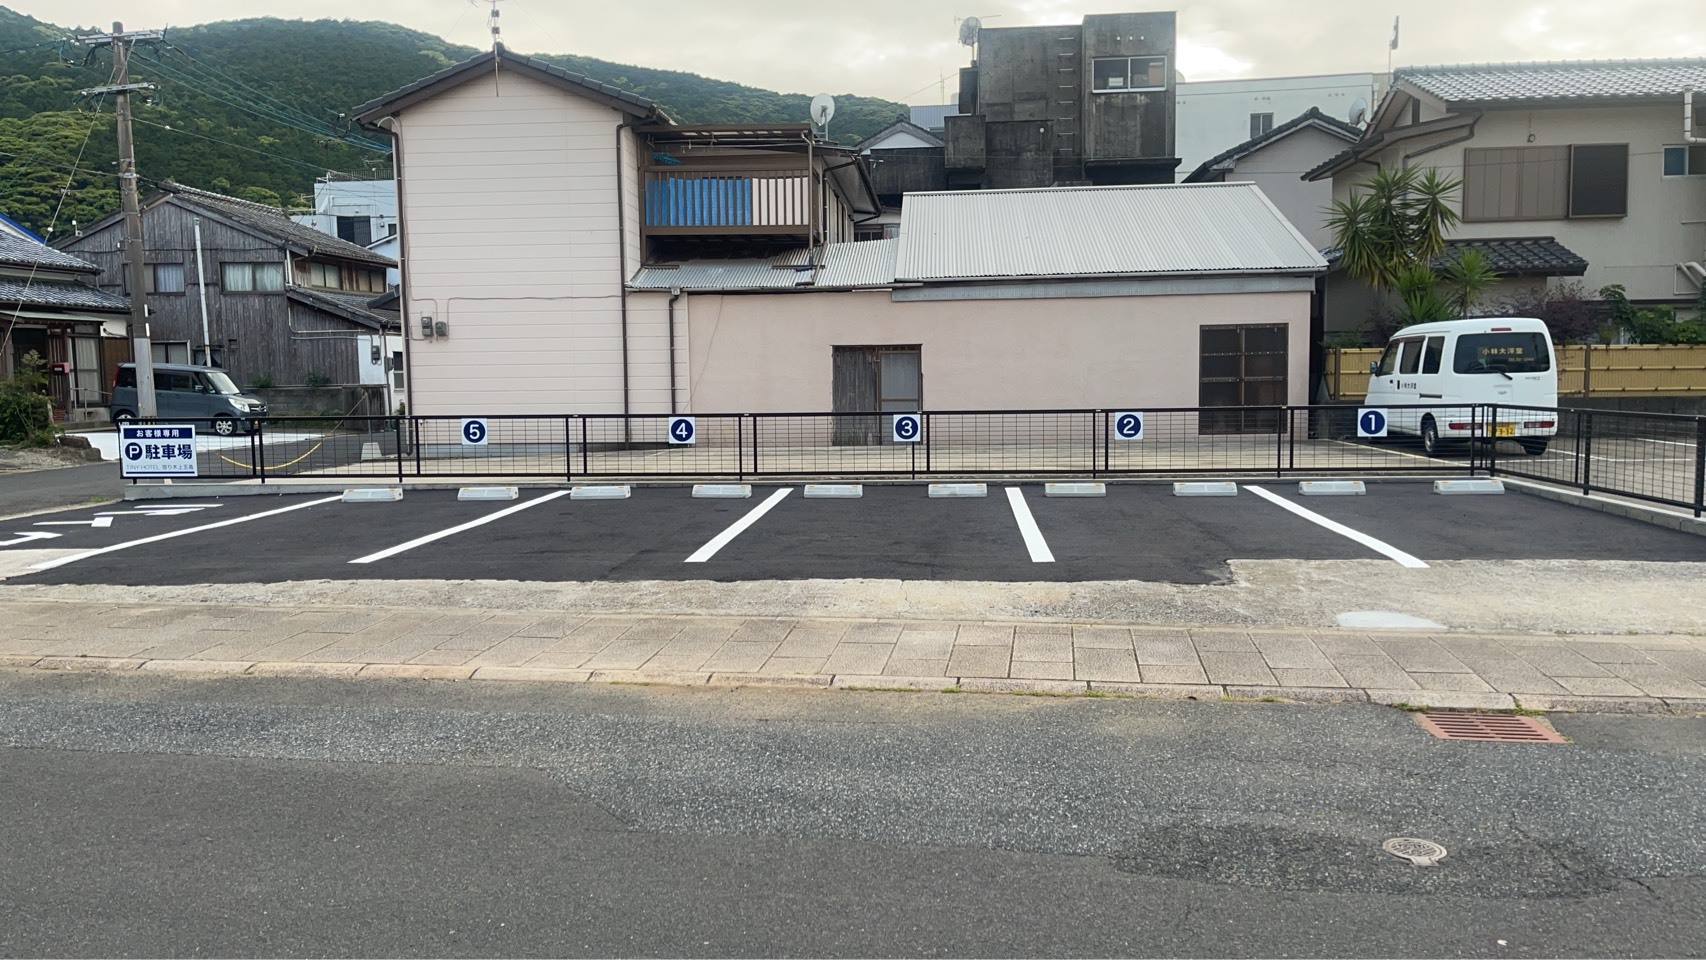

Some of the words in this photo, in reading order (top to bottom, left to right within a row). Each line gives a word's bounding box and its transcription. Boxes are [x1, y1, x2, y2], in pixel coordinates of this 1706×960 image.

[676, 422, 688, 438] 4
[901, 420, 913, 436] 3
[1123, 418, 1135, 434] 2
[1368, 414, 1376, 431] 1
[136, 429, 180, 438] お客様専用
[469, 424, 480, 440] 5
[129, 445, 140, 458] P
[145, 444, 193, 460] 駐車場
